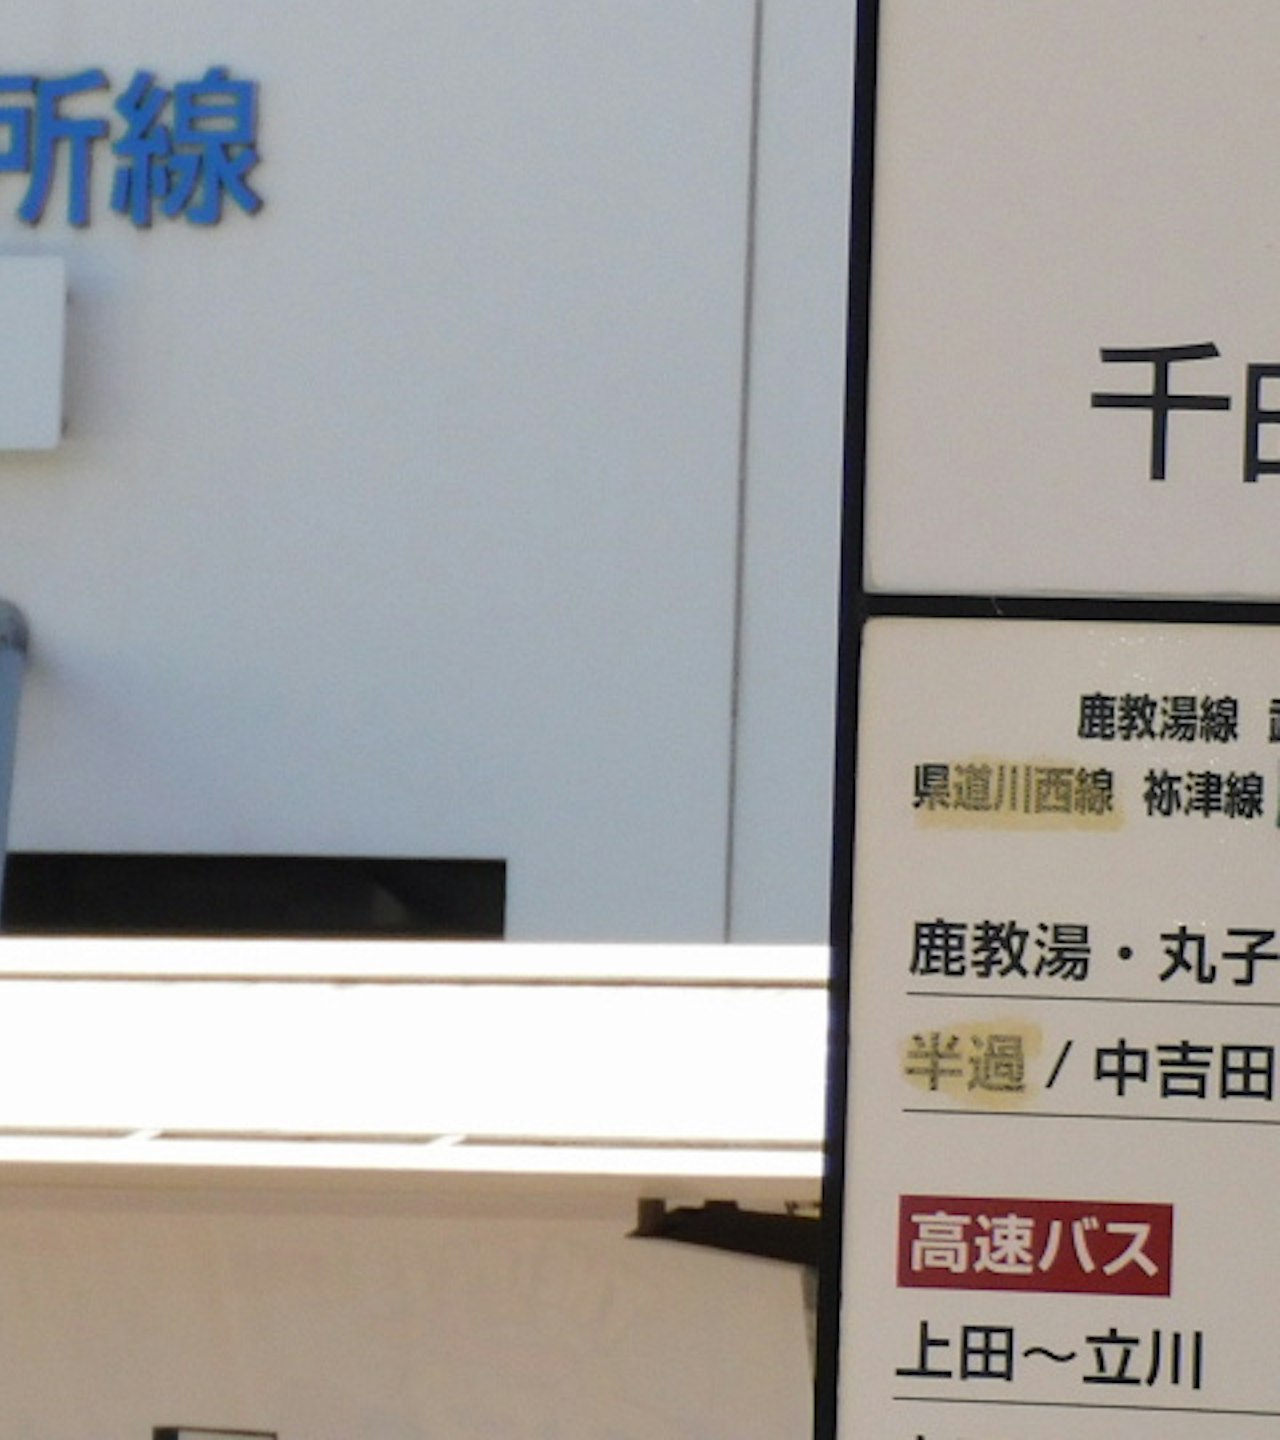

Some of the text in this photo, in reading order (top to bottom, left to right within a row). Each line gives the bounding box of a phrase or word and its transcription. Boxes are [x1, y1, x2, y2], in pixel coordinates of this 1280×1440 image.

[1091, 341, 1280, 484] 千
[1078, 692, 1239, 743] 鹿教湯線
[913, 763, 1115, 815] 県道川西線
[910, 1211, 1159, 1278] 高速バス
